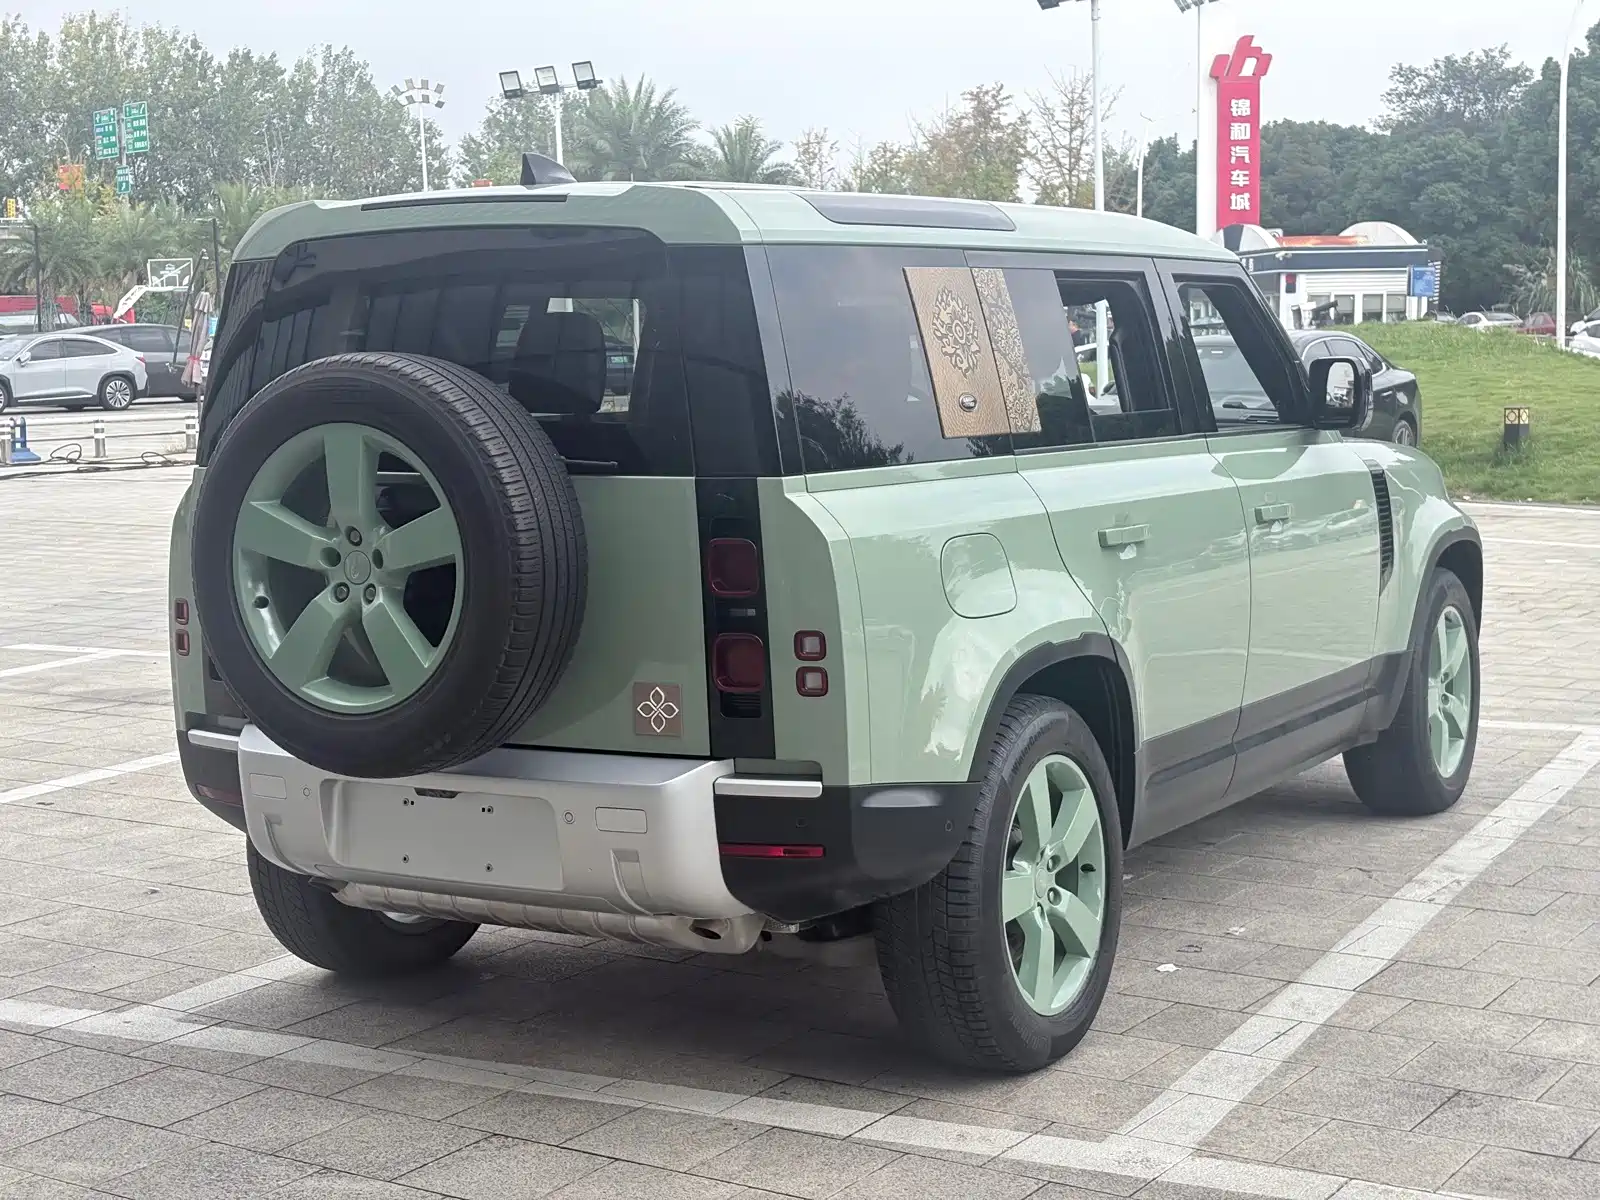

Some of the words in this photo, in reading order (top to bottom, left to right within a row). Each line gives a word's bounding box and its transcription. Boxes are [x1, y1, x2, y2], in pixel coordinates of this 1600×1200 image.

[1230, 98, 1250, 211] 锦和汽车城
